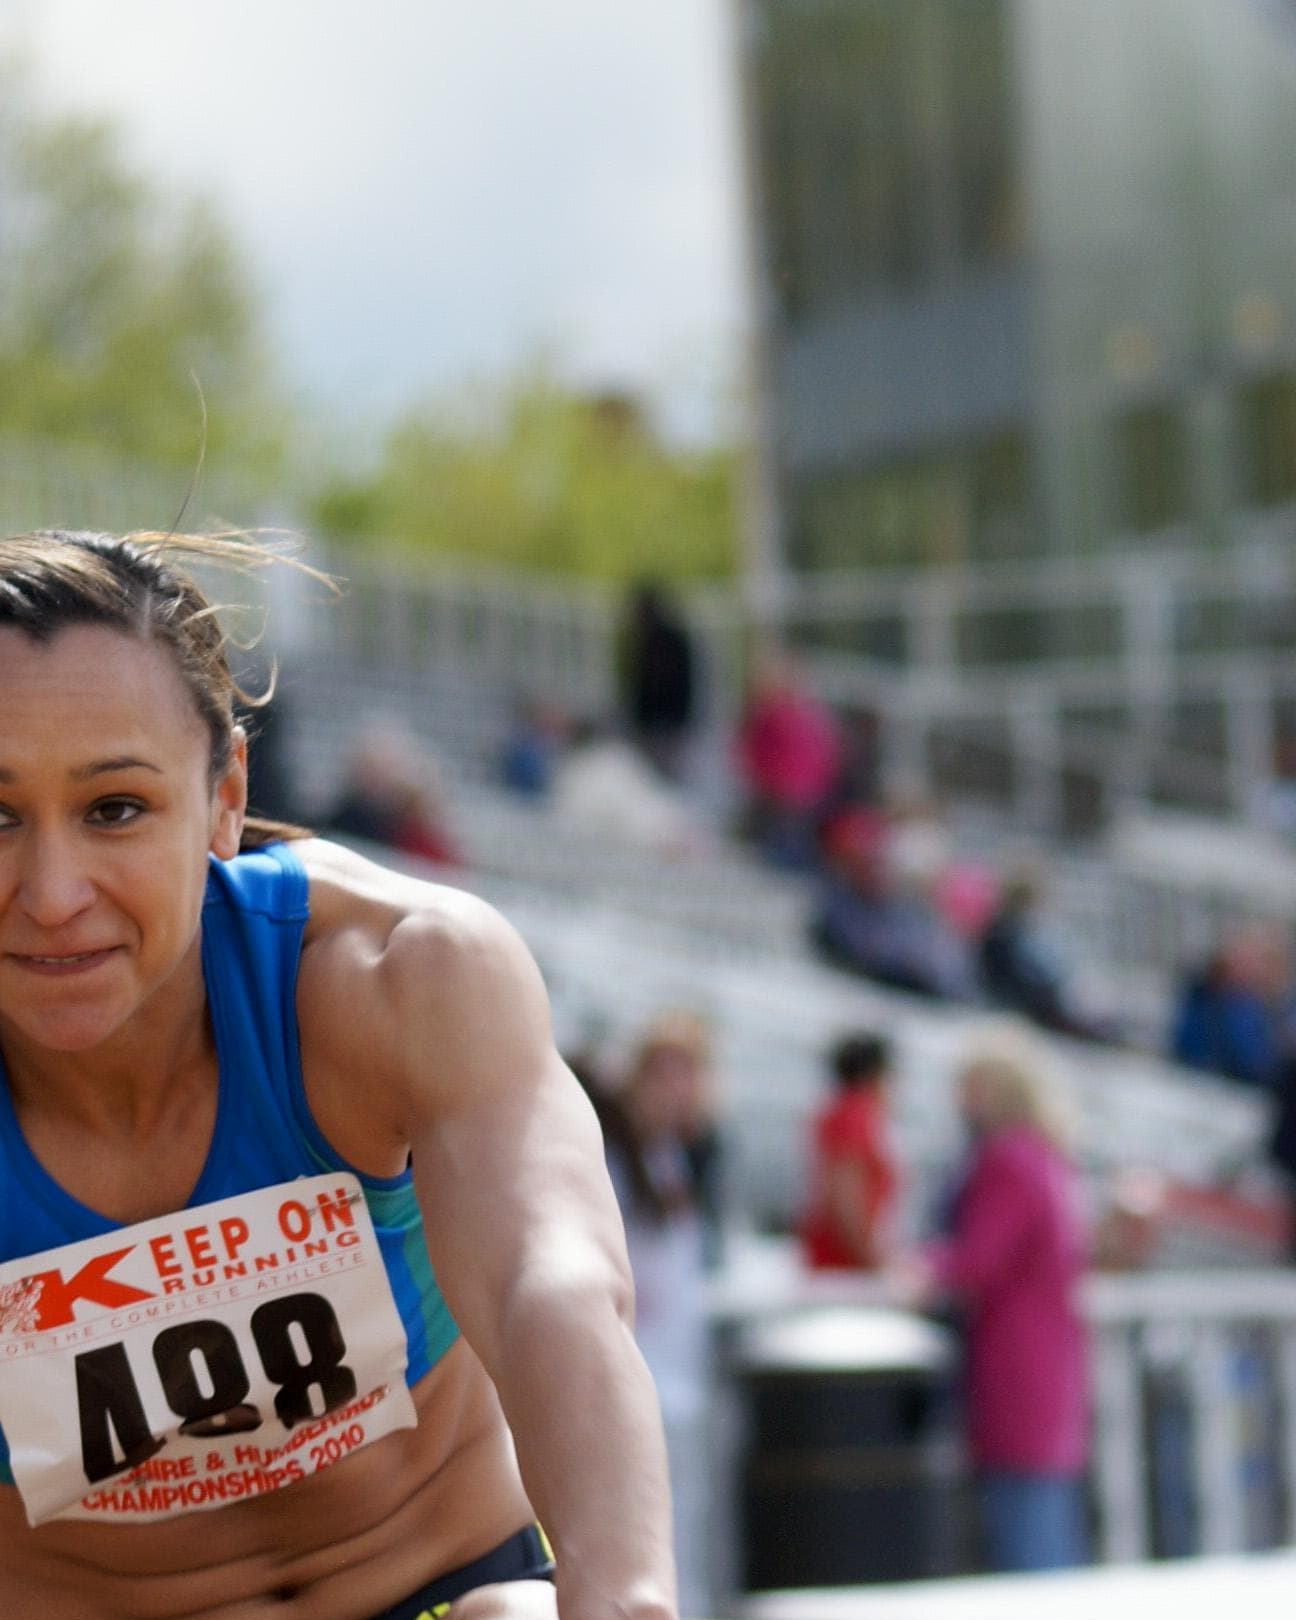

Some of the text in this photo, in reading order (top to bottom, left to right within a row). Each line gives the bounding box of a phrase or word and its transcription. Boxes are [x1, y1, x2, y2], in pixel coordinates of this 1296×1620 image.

[277, 1187, 355, 1243] ON
[161, 1230, 361, 1295] RUNNING
[50, 1325, 94, 1347] THE
[110, 1284, 241, 1329] COMPLETE
[257, 1252, 365, 1291] ATHLETE
[81, 1422, 366, 1512] CHAMPIONSHIPS 2010
[205, 1450, 225, 1472] &
